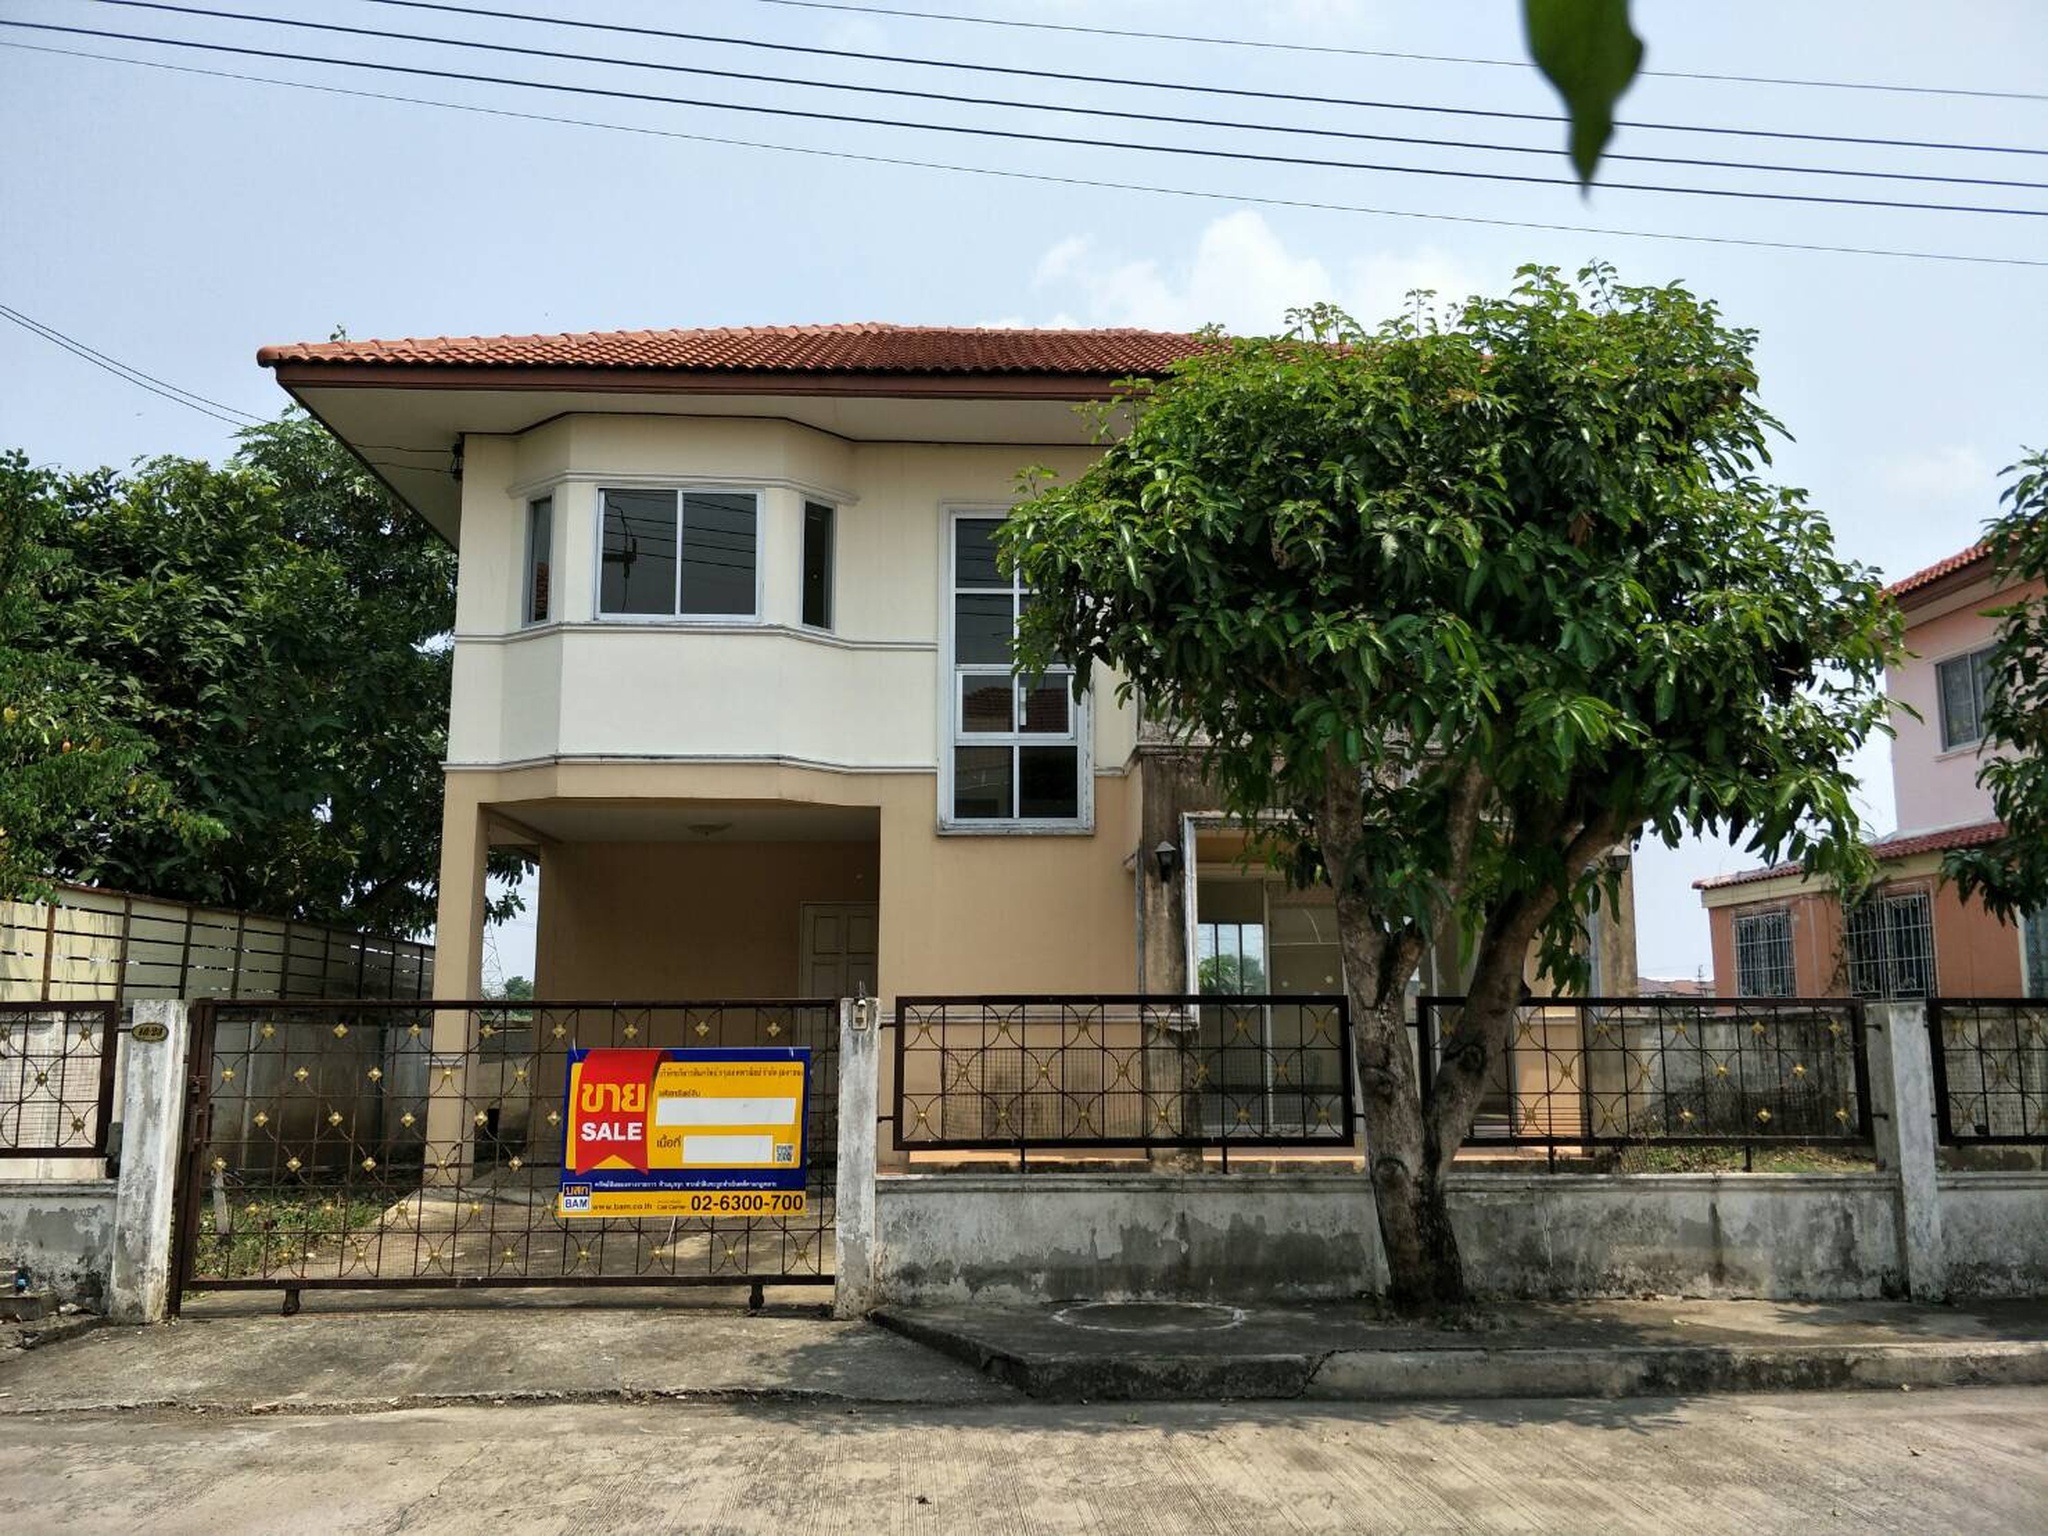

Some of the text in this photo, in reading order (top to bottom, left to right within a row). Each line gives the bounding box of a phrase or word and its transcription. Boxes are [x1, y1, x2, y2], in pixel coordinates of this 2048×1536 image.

[582, 1083, 646, 1112] ขาย
[581, 1122, 643, 1141] SALE
[656, 1134, 682, 1149] เนื้อที่
[565, 1199, 588, 1209] BAM
[691, 1195, 803, 1211] 02-6300-700
